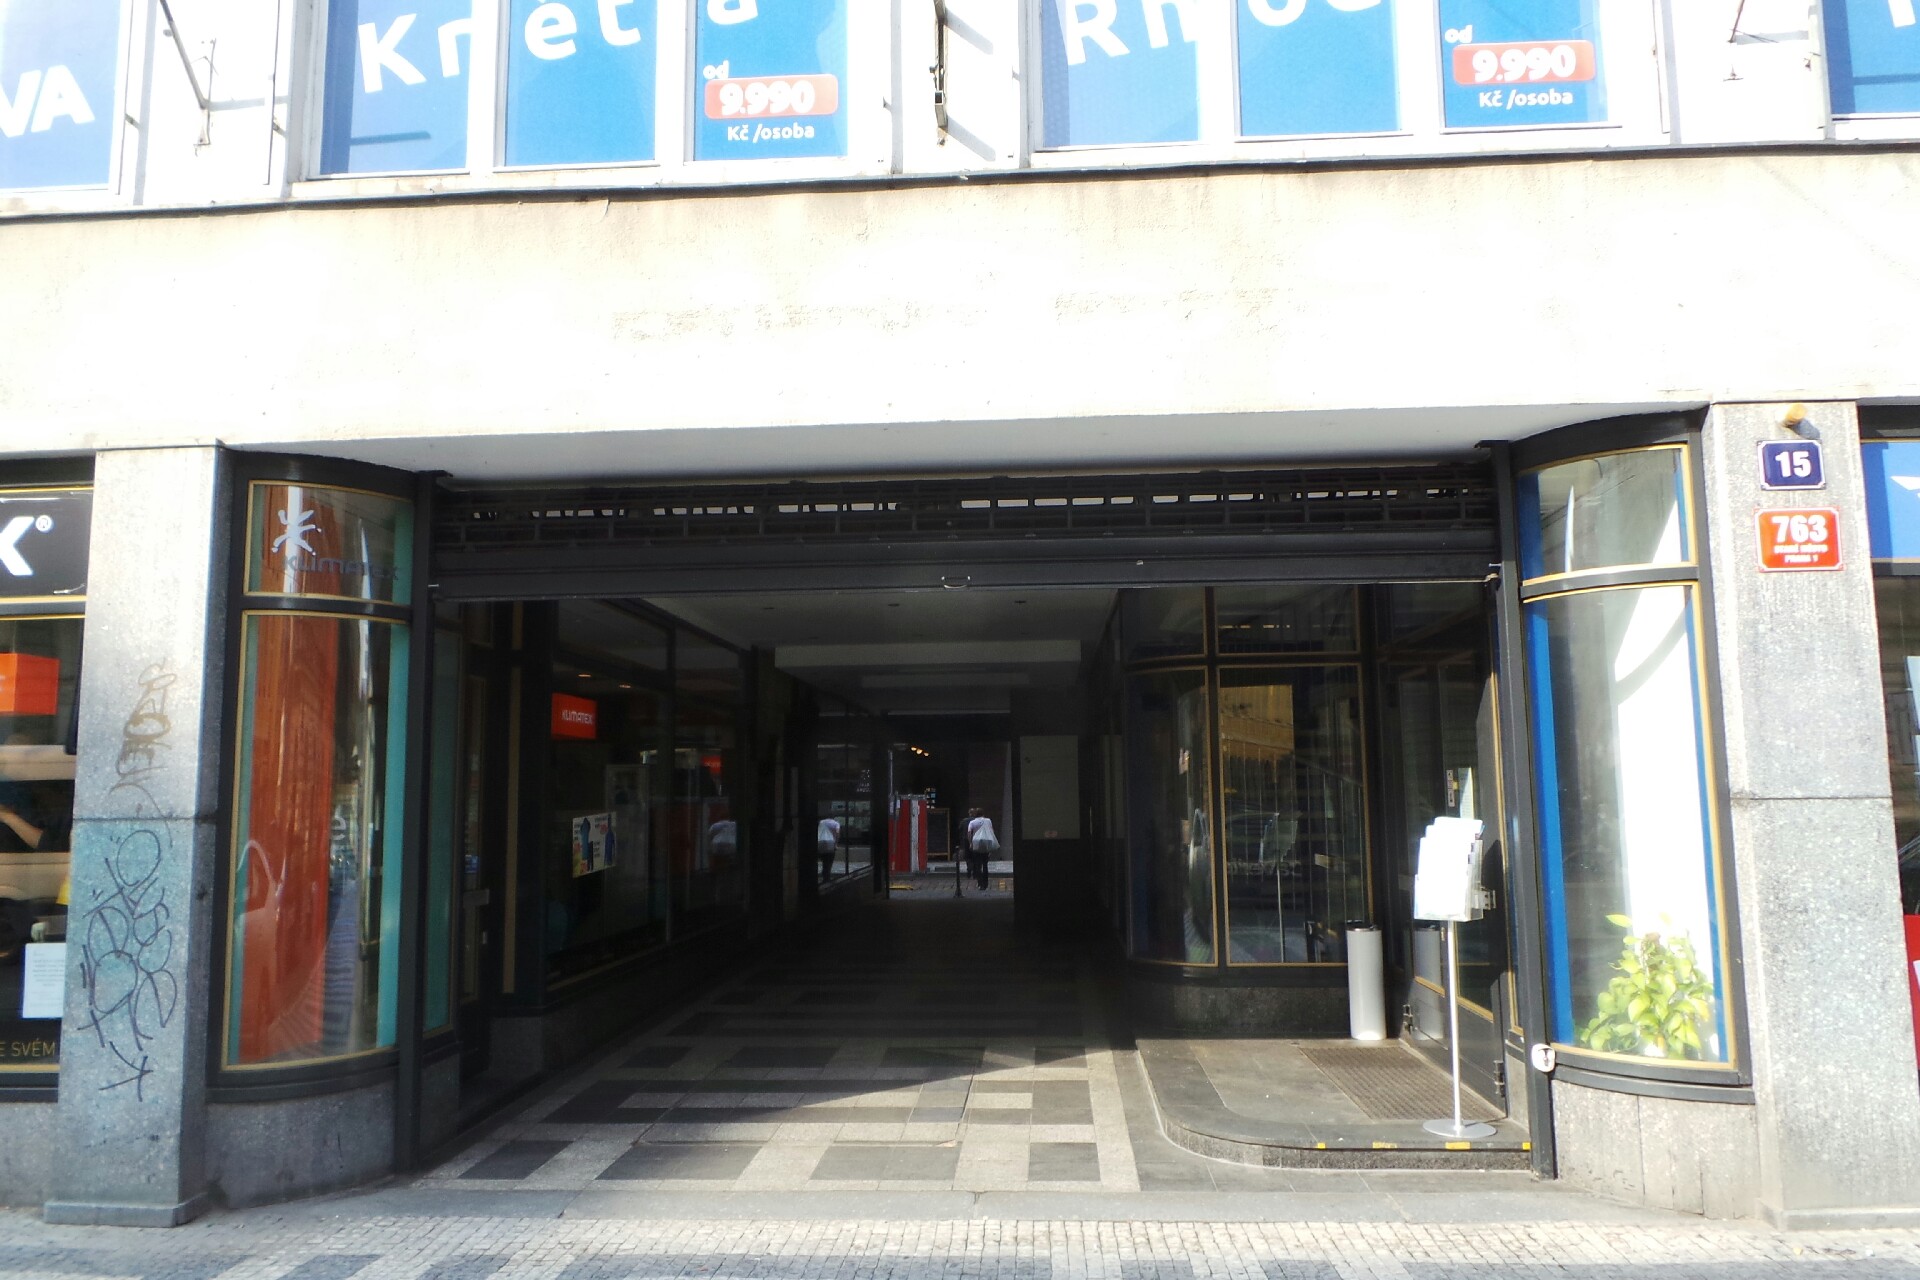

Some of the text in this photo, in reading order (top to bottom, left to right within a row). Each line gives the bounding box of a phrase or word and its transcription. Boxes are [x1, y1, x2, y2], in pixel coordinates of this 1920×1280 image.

[1445, 25, 1472, 43] od
[703, 60, 729, 80] od
[1472, 45, 1576, 82] 9.990
[720, 80, 815, 116] 9.990
[1479, 89, 1573, 109] Kč /osoba
[727, 122, 815, 143] Kč /osoba
[1775, 450, 1812, 478] 15
[1771, 514, 1828, 543] 763
[11, 1038, 55, 1057] SVÉM
